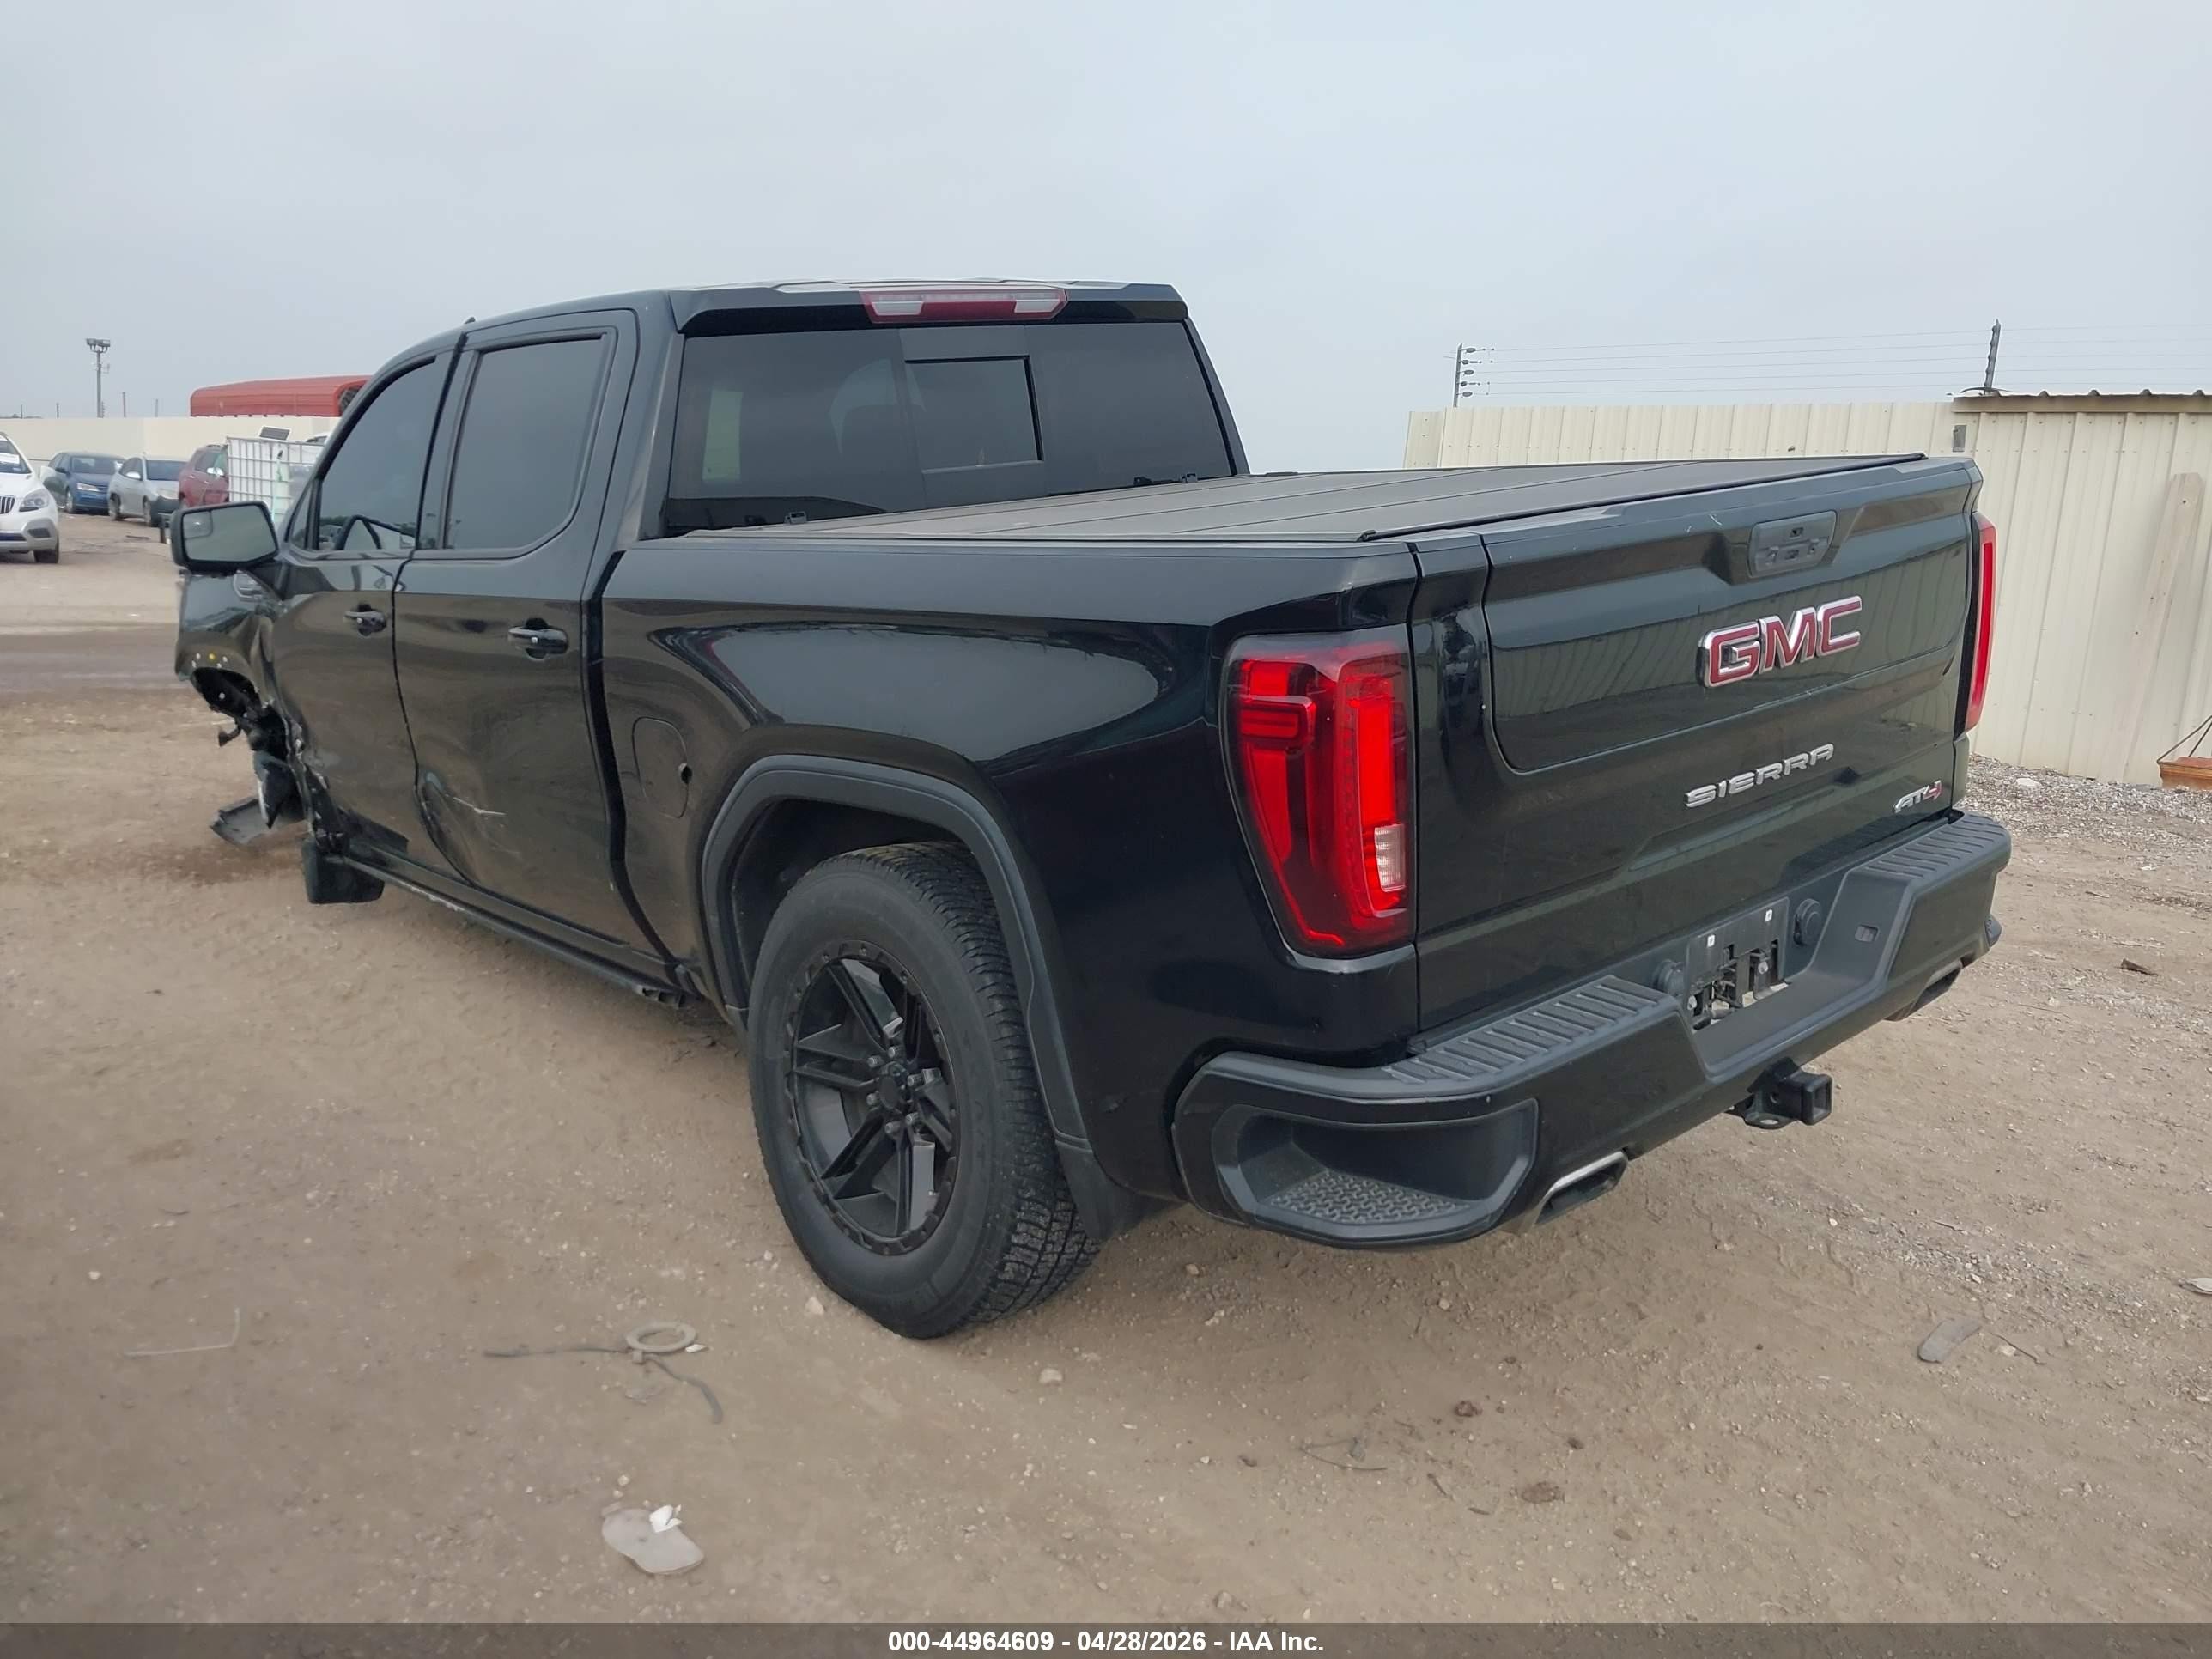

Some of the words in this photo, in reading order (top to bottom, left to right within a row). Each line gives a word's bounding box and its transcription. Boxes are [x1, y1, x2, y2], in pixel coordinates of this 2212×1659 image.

[1696, 595, 1863, 688] GMC
[1685, 743, 1834, 808] SIERRA
[1893, 780, 1942, 814] AT4
